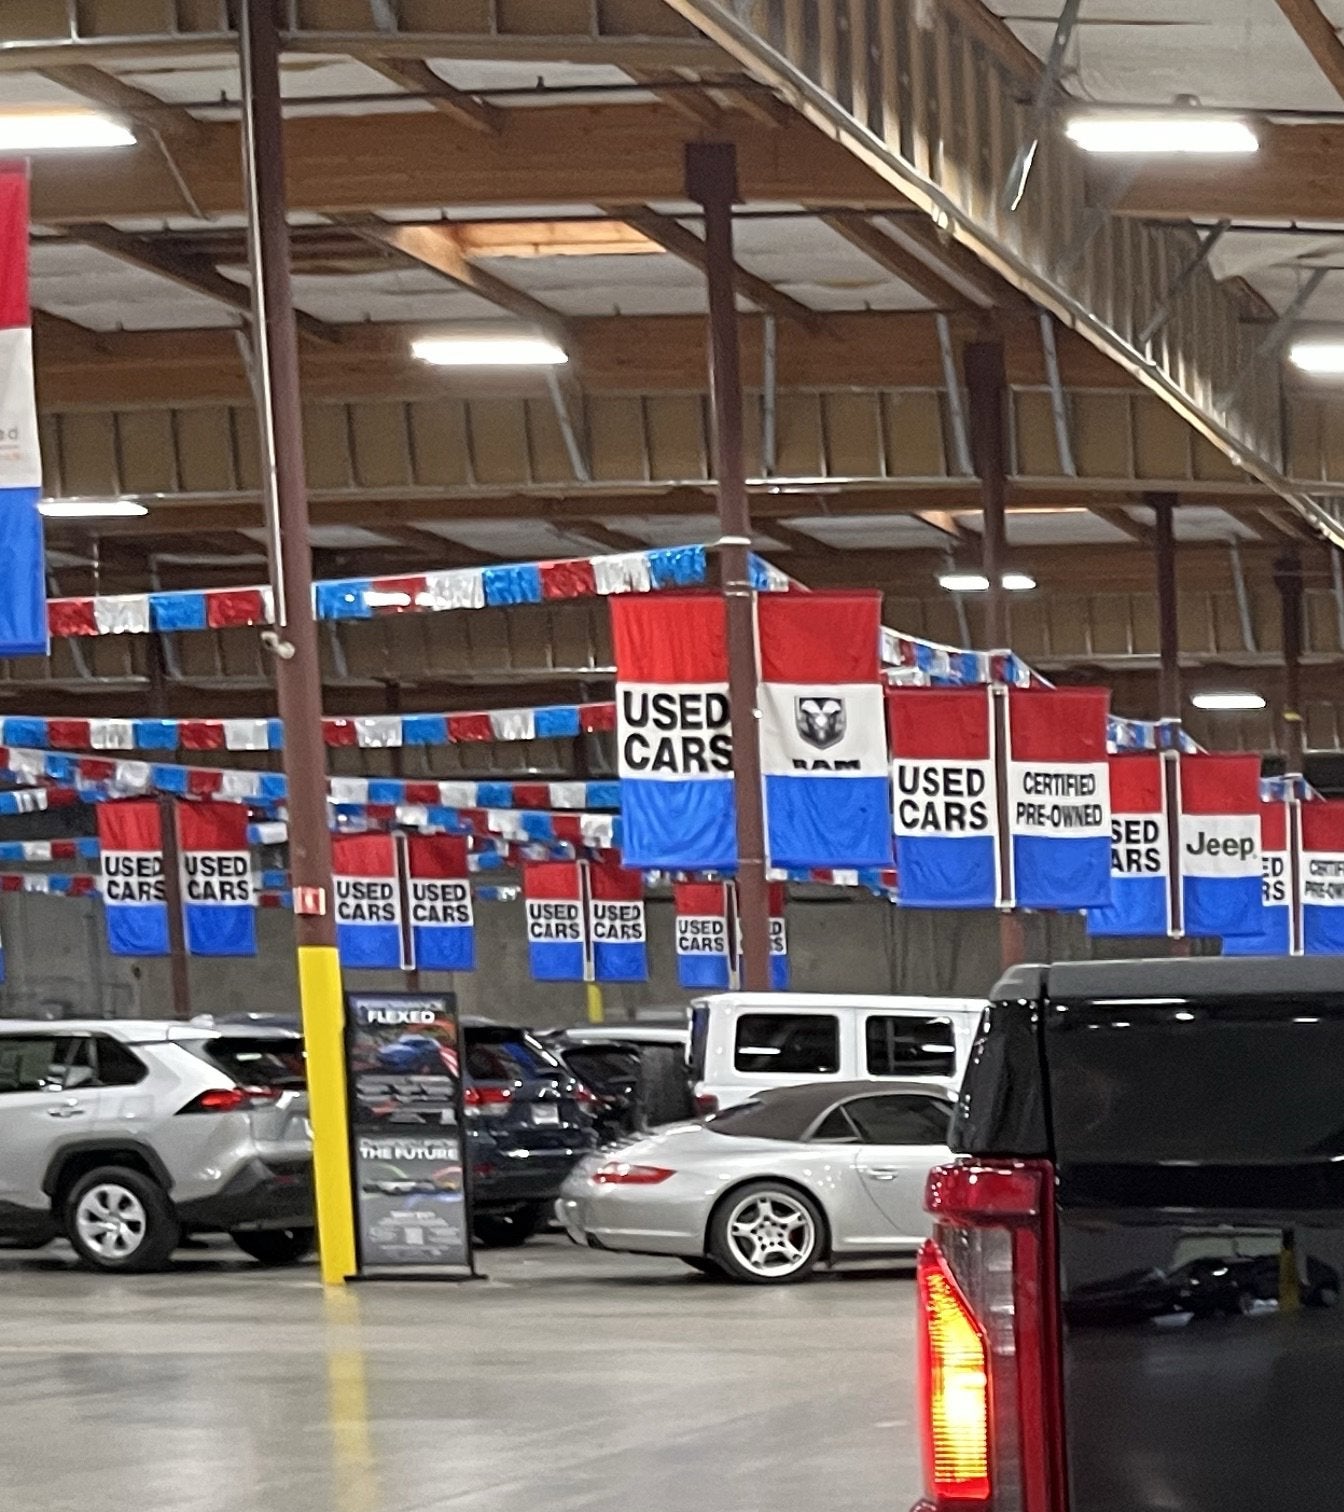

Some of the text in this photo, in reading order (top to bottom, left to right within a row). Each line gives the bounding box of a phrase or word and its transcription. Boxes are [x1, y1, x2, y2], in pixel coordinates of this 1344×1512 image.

[623, 690, 732, 731] USED
[623, 732, 733, 773] CARS
[792, 759, 861, 771] RAM
[898, 765, 986, 798] USED
[1022, 771, 1096, 797] CERTIFIED
[899, 799, 989, 831] CARS
[1016, 801, 1103, 828] PRE-OWNED
[1111, 819, 1159, 844] SED
[1186, 831, 1255, 861] Jeep
[105, 855, 163, 877] USED
[184, 855, 248, 877] USED
[1111, 847, 1161, 873] ARS
[106, 879, 165, 901] CARS
[187, 879, 249, 901] CARS
[336, 880, 394, 901] USED
[412, 882, 467, 902] USED
[337, 901, 396, 922] CARS
[412, 903, 470, 923] CARS
[529, 903, 579, 921] USED
[593, 903, 641, 921] USED
[530, 921, 581, 939] CARS
[593, 921, 643, 939] CARS
[678, 919, 724, 935] USED
[678, 936, 725, 952] CARS
